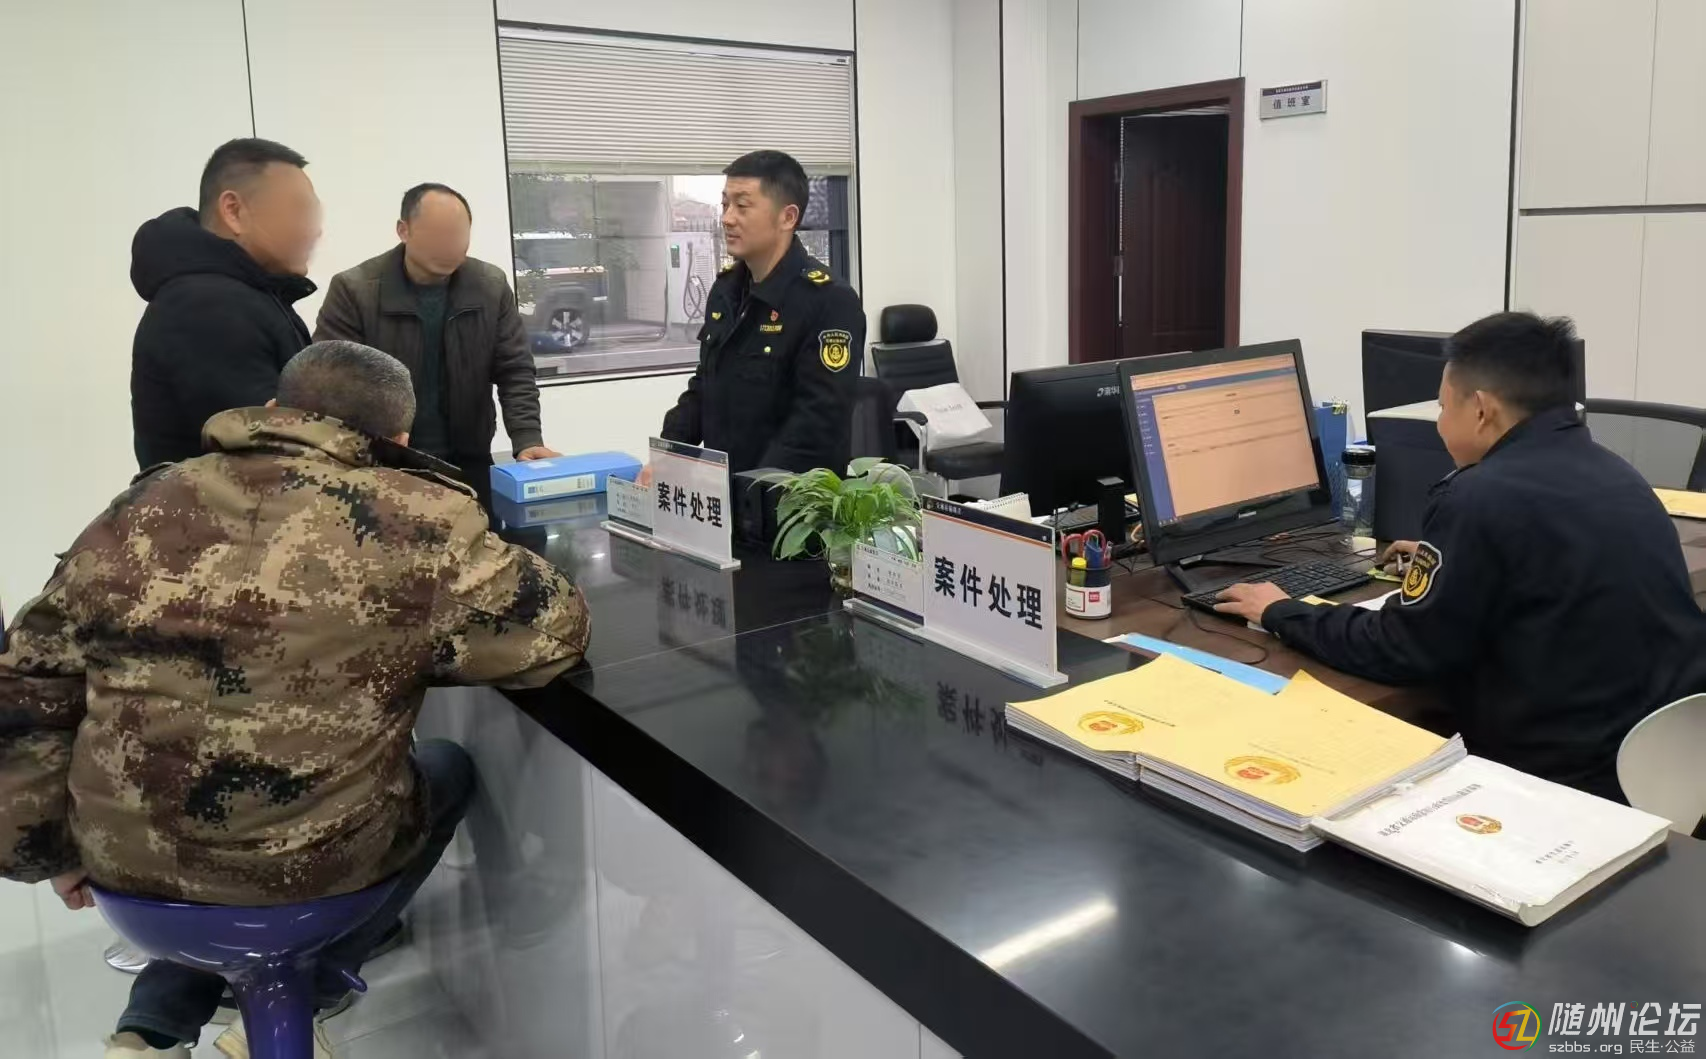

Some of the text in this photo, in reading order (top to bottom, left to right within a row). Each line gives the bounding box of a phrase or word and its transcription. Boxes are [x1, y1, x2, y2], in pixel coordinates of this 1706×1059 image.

[657, 481, 723, 528] 案件处理
[934, 556, 1043, 631] 案件处理
